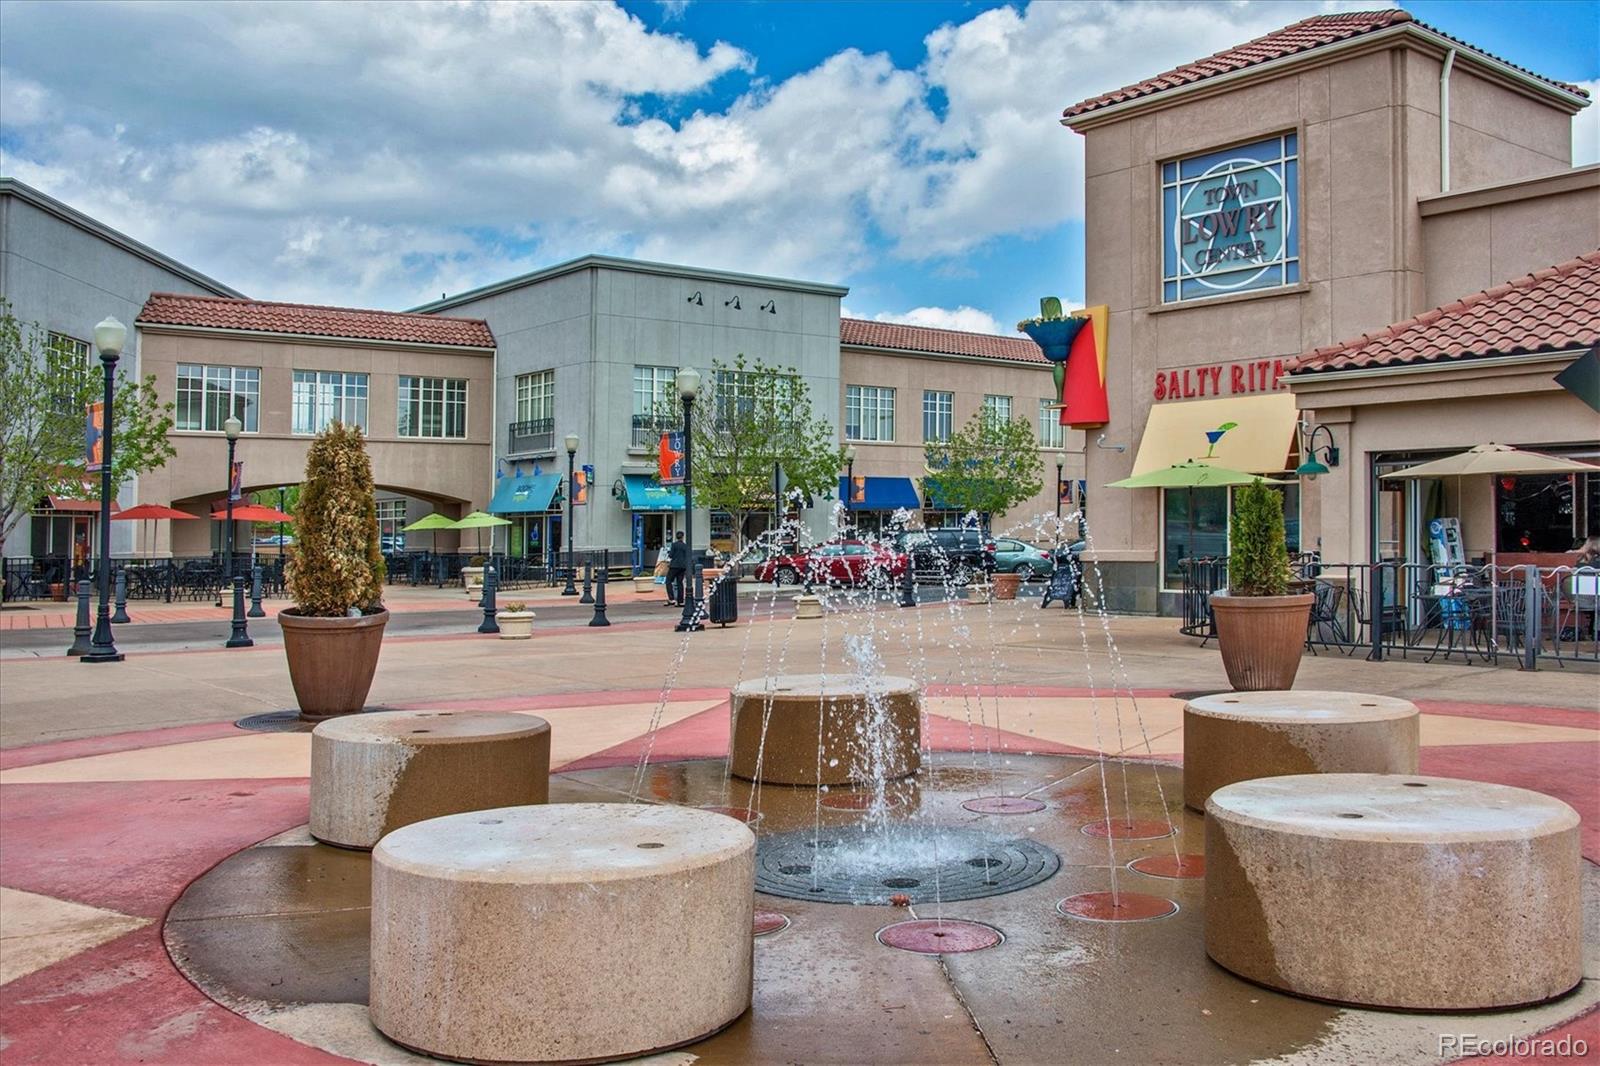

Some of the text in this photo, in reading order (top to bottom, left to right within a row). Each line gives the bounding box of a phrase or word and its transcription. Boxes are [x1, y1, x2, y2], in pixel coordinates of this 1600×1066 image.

[1203, 179, 1259, 206] TOWN
[1182, 201, 1279, 245] LOWRY
[1195, 240, 1267, 267] CENTER
[1154, 366, 1222, 400] SALTY
[674, 432, 682, 477] LOWRY
